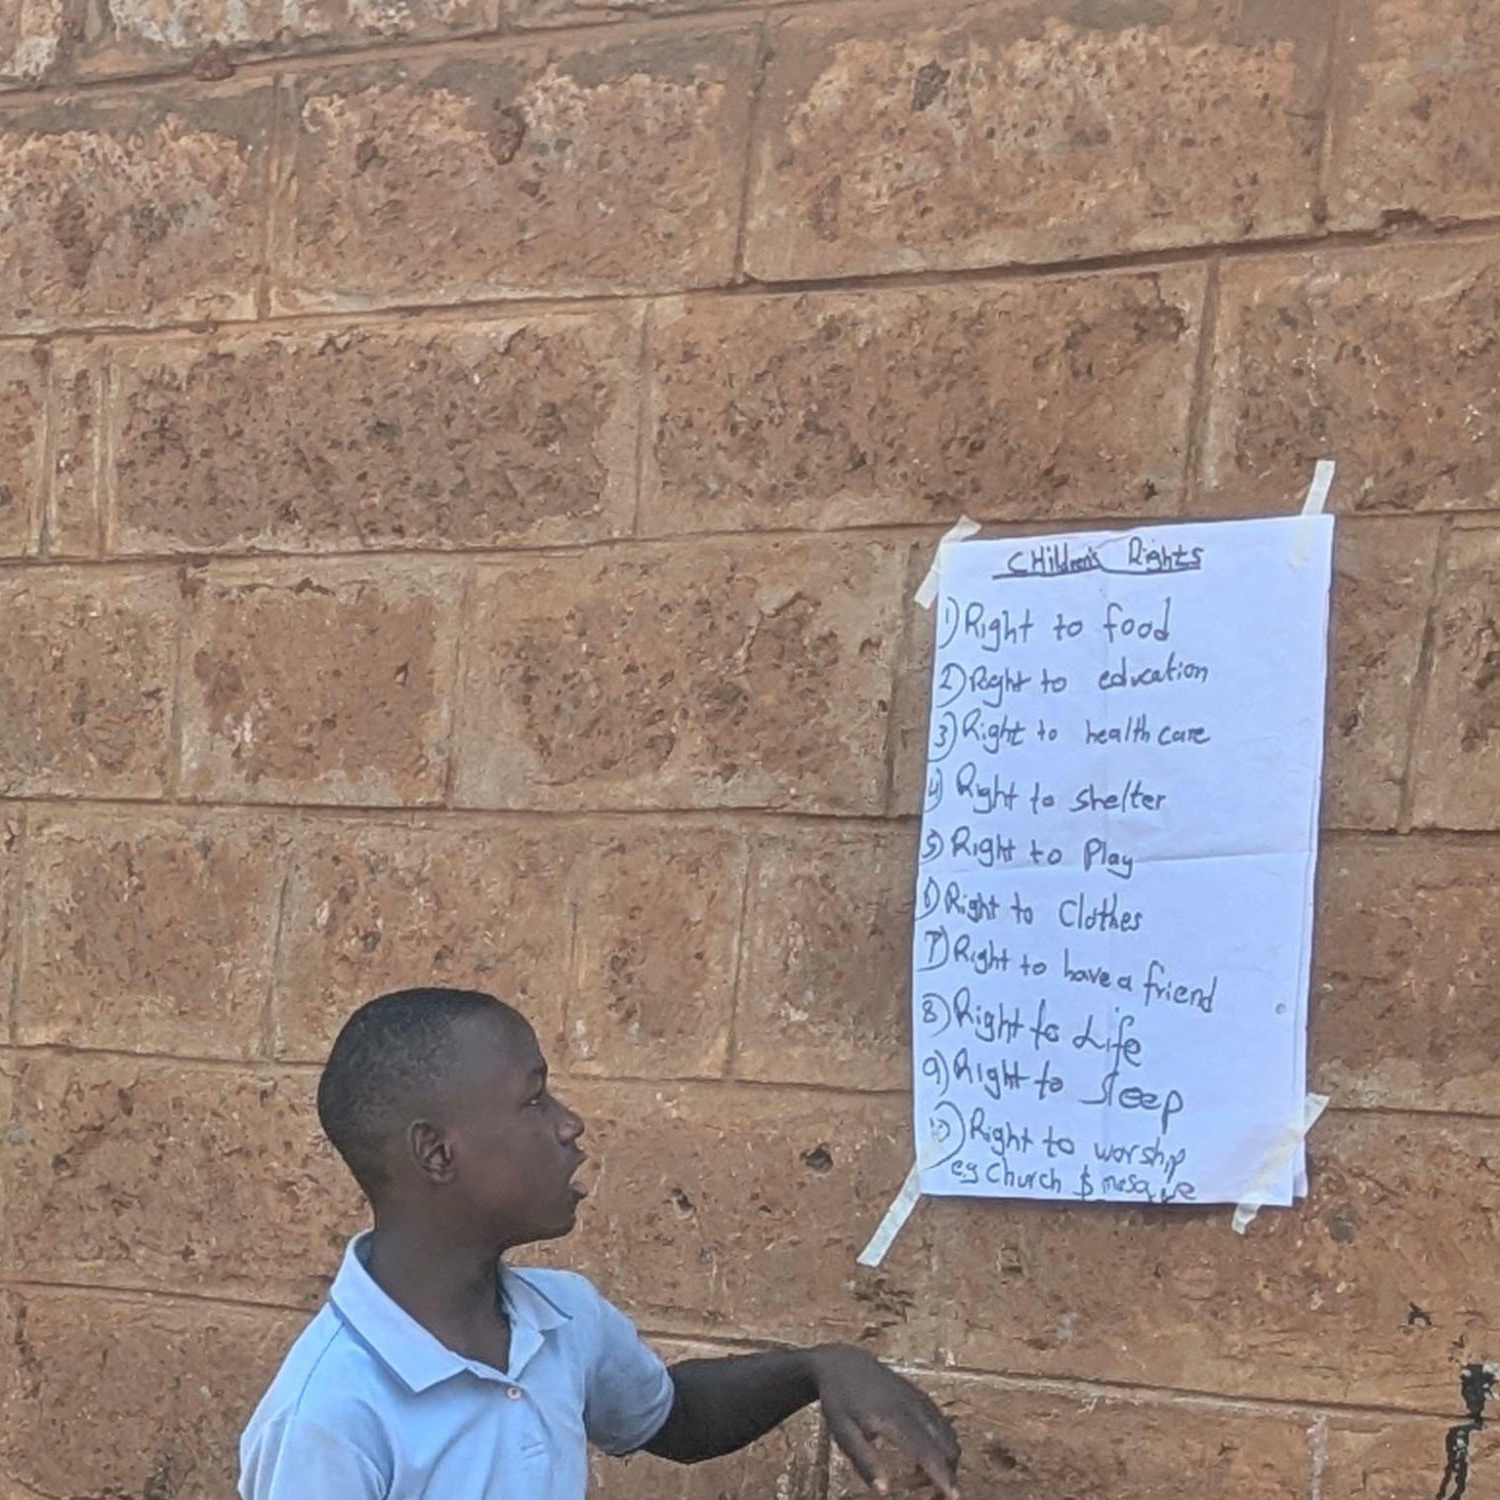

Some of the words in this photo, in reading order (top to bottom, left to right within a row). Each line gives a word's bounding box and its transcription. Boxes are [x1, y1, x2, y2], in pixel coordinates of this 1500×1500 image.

[1128, 536, 1205, 572] Rights
[965, 602, 1034, 652] Right
[1053, 613, 1083, 641] to
[1104, 597, 1172, 643] food
[970, 665, 1031, 708] Right
[1040, 668, 1067, 693] to
[1099, 651, 1209, 690] education
[963, 708, 1026, 754] Right
[1037, 719, 1058, 741] to
[1085, 714, 1150, 745] health
[1158, 724, 1211, 746] care
[956, 762, 1019, 814] Right
[1030, 782, 1055, 814] to
[1070, 780, 1167, 813] shelter
[951, 825, 1015, 867] Right
[1030, 840, 1062, 865] to
[1083, 837, 1134, 879] Play
[945, 882, 1000, 923] Right
[1010, 892, 1033, 925] to
[1059, 892, 1143, 932] Clothes
[953, 934, 1010, 974] Right
[1020, 955, 1047, 976] to
[1064, 948, 1111, 988] have
[1117, 974, 1133, 992] a
[1143, 960, 1217, 1013] friend
[953, 987, 1024, 1043] Right
[1030, 999, 1060, 1049] to
[1072, 1007, 1142, 1072] Life
[953, 1048, 1030, 1100] Right
[1034, 1060, 1064, 1100] to
[970, 1107, 1034, 1156] Right
[1043, 1125, 1075, 1158] to
[1094, 1137, 1187, 1184] worship
[985, 1157, 1062, 1193] Church
